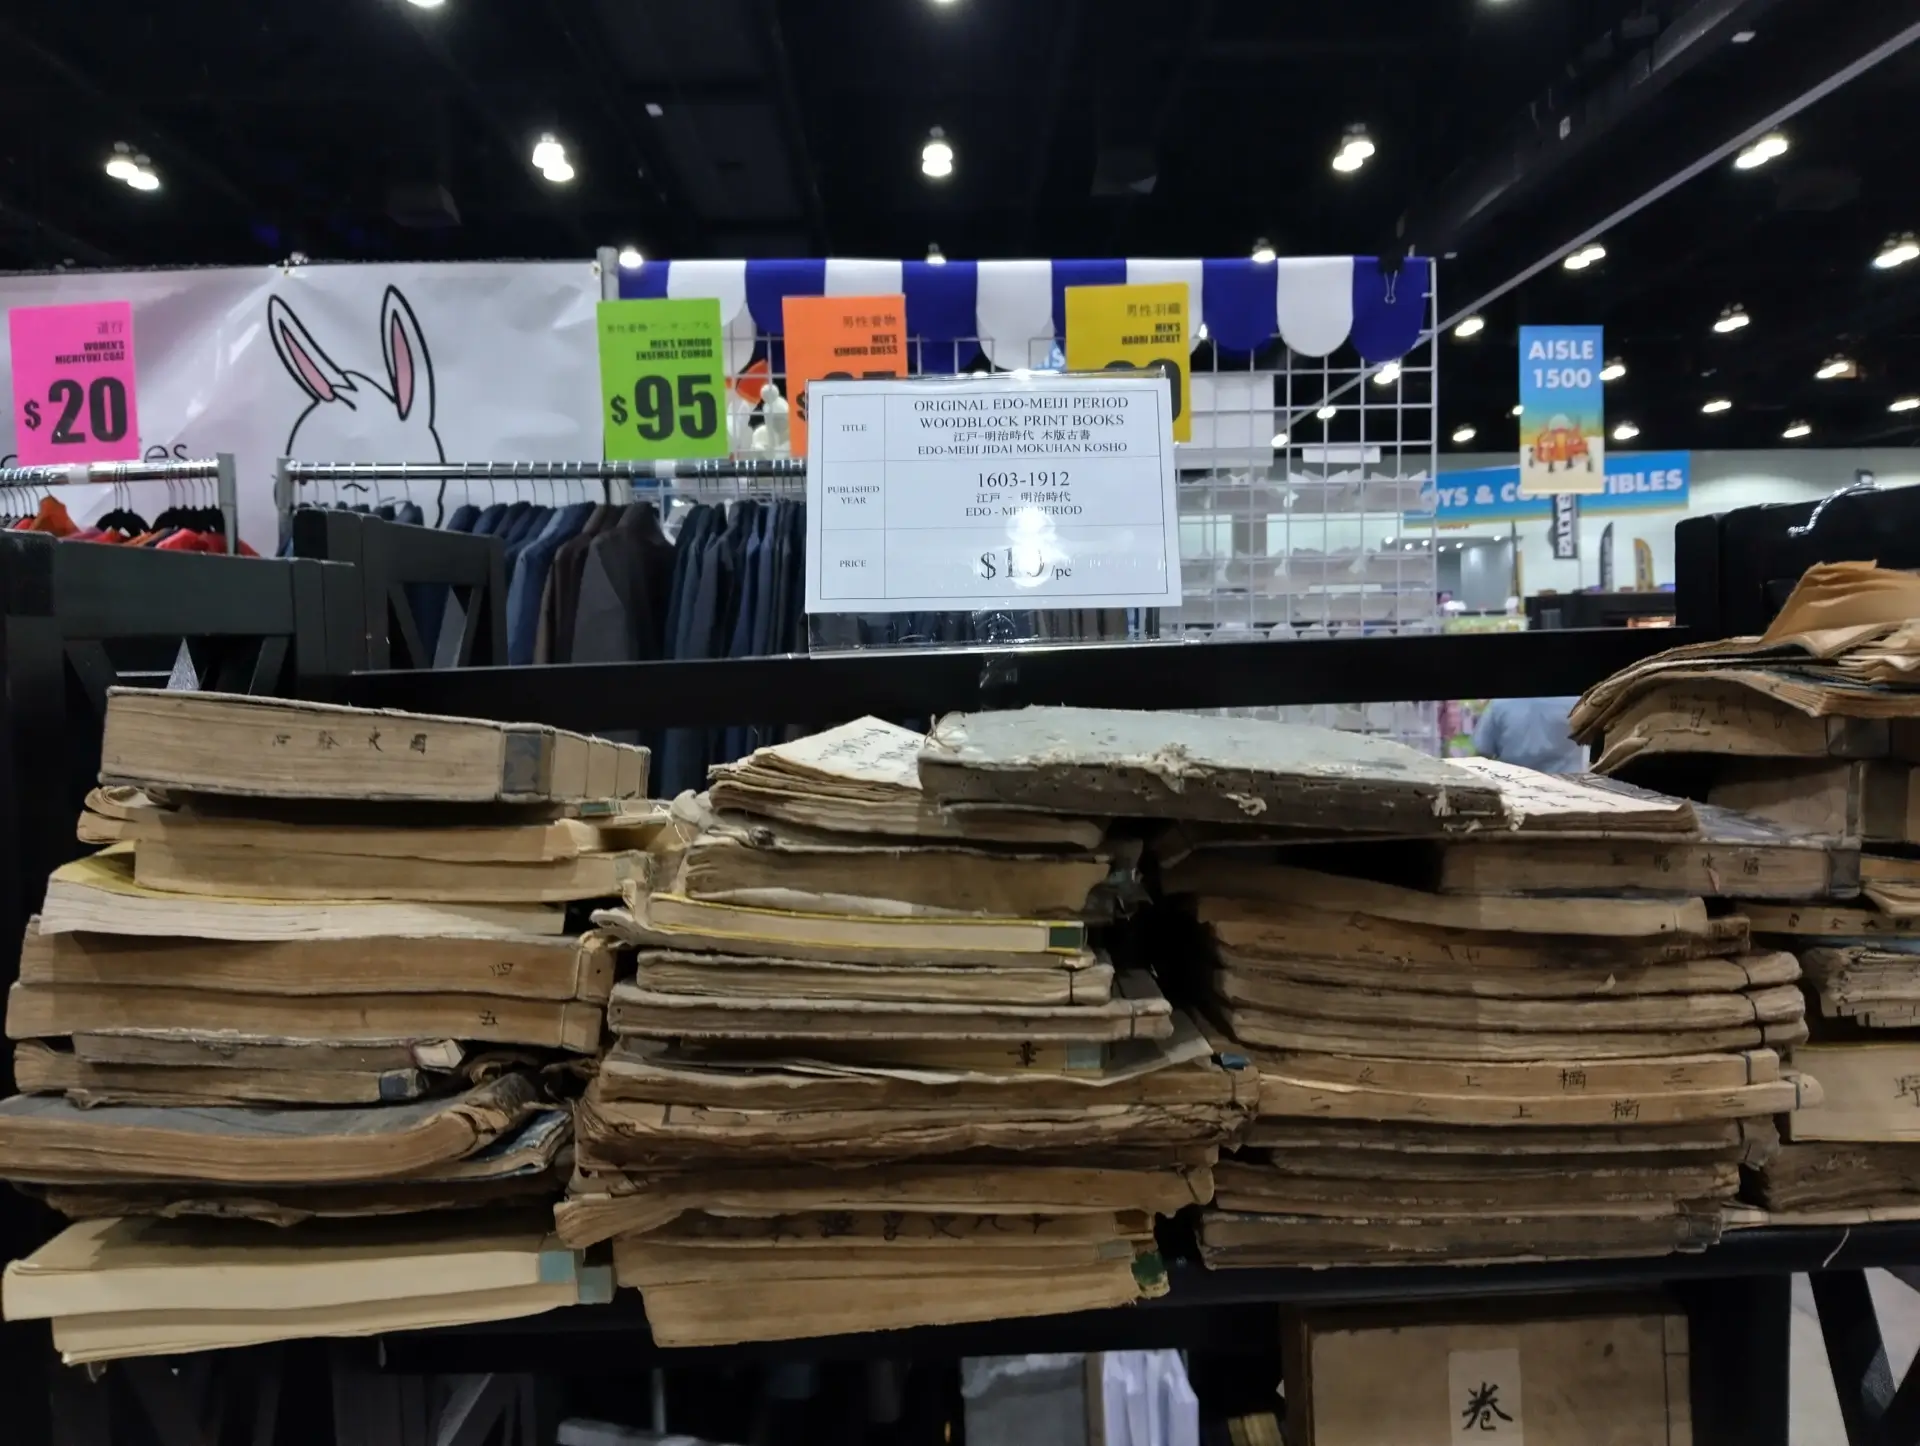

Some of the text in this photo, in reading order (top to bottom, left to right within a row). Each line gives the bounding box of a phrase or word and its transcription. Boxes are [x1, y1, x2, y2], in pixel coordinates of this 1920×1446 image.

[1155, 322, 1181, 333] MEN'S
[1151, 334, 1181, 344] JACKET
[84, 340, 124, 351] WOMEN'S
[1528, 340, 1595, 361] AISLE
[1533, 367, 1592, 389] 1500
[914, 397, 1129, 412] ORIGINAL EDO-MEIJI PERIOD
[920, 414, 1124, 428] WOODBLOCK PRINT BOOKS
[841, 424, 867, 432] TITLE
[1041, 429, 1091, 441] 木版古書
[918, 442, 1127, 455] EDO-MEIJI JIDAI MOKUHAN KOSHO
[978, 471, 1070, 488] 1603-1912
[828, 485, 879, 494] PUBLISHED
[1475, 485, 1494, 505] &
[1020, 491, 1071, 503] 明治時代
[965, 507, 992, 517] EDO
[839, 559, 867, 568] PRICE
